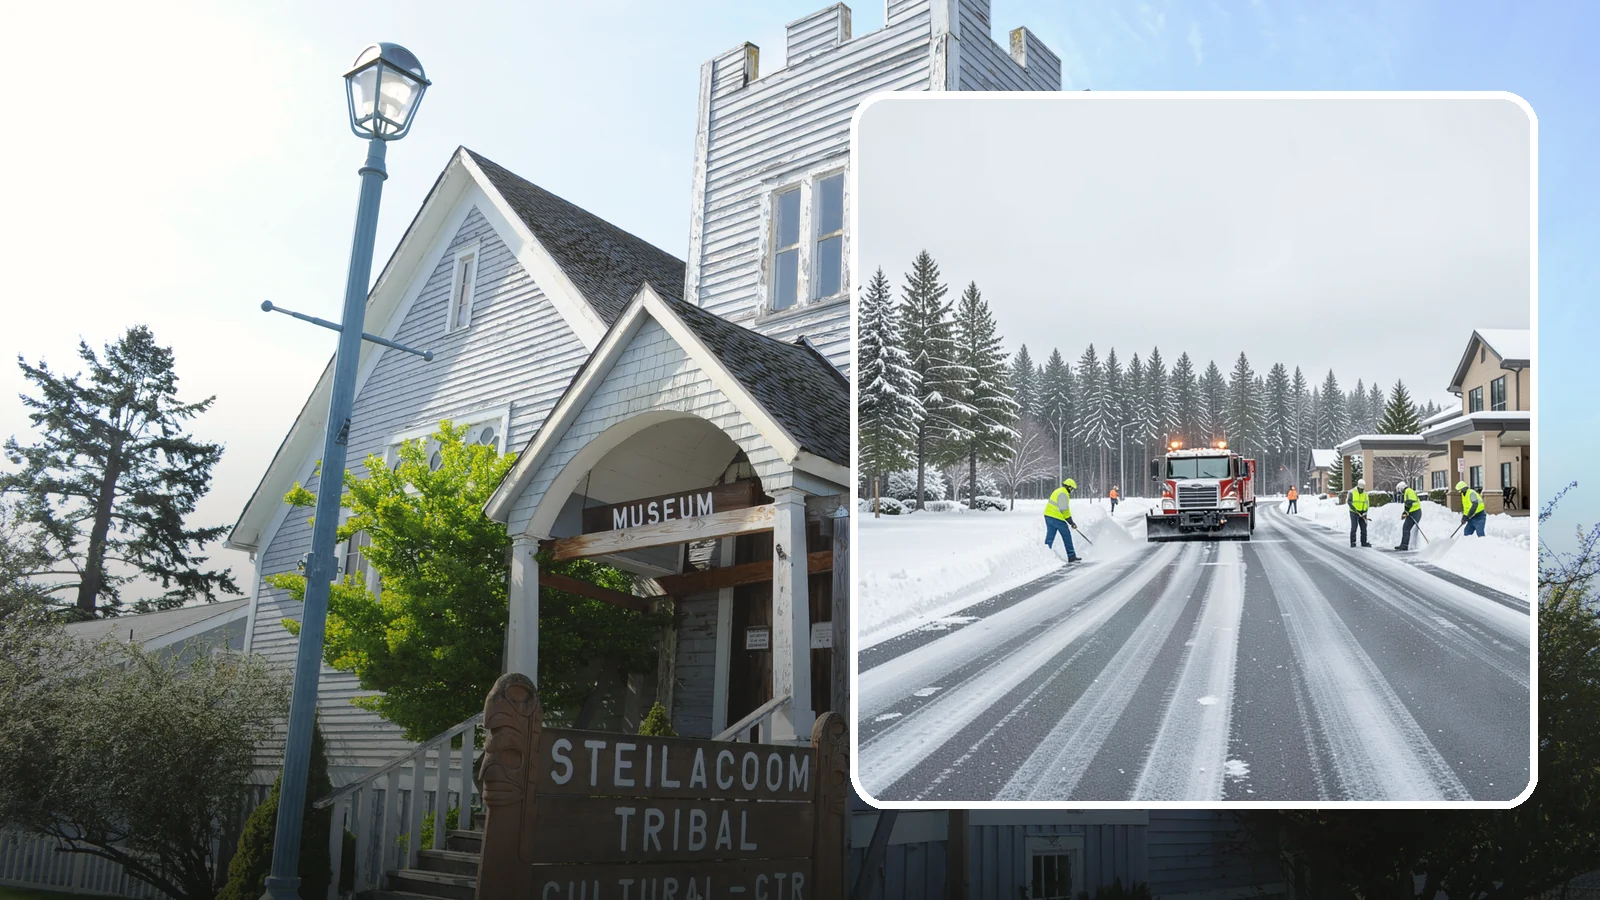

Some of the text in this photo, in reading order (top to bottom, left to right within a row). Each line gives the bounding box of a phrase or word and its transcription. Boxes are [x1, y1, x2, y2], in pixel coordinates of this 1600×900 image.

[612, 491, 714, 531] MUSEUM
[550, 738, 810, 793] STEILACOOM
[614, 806, 758, 852] TRIBAL
